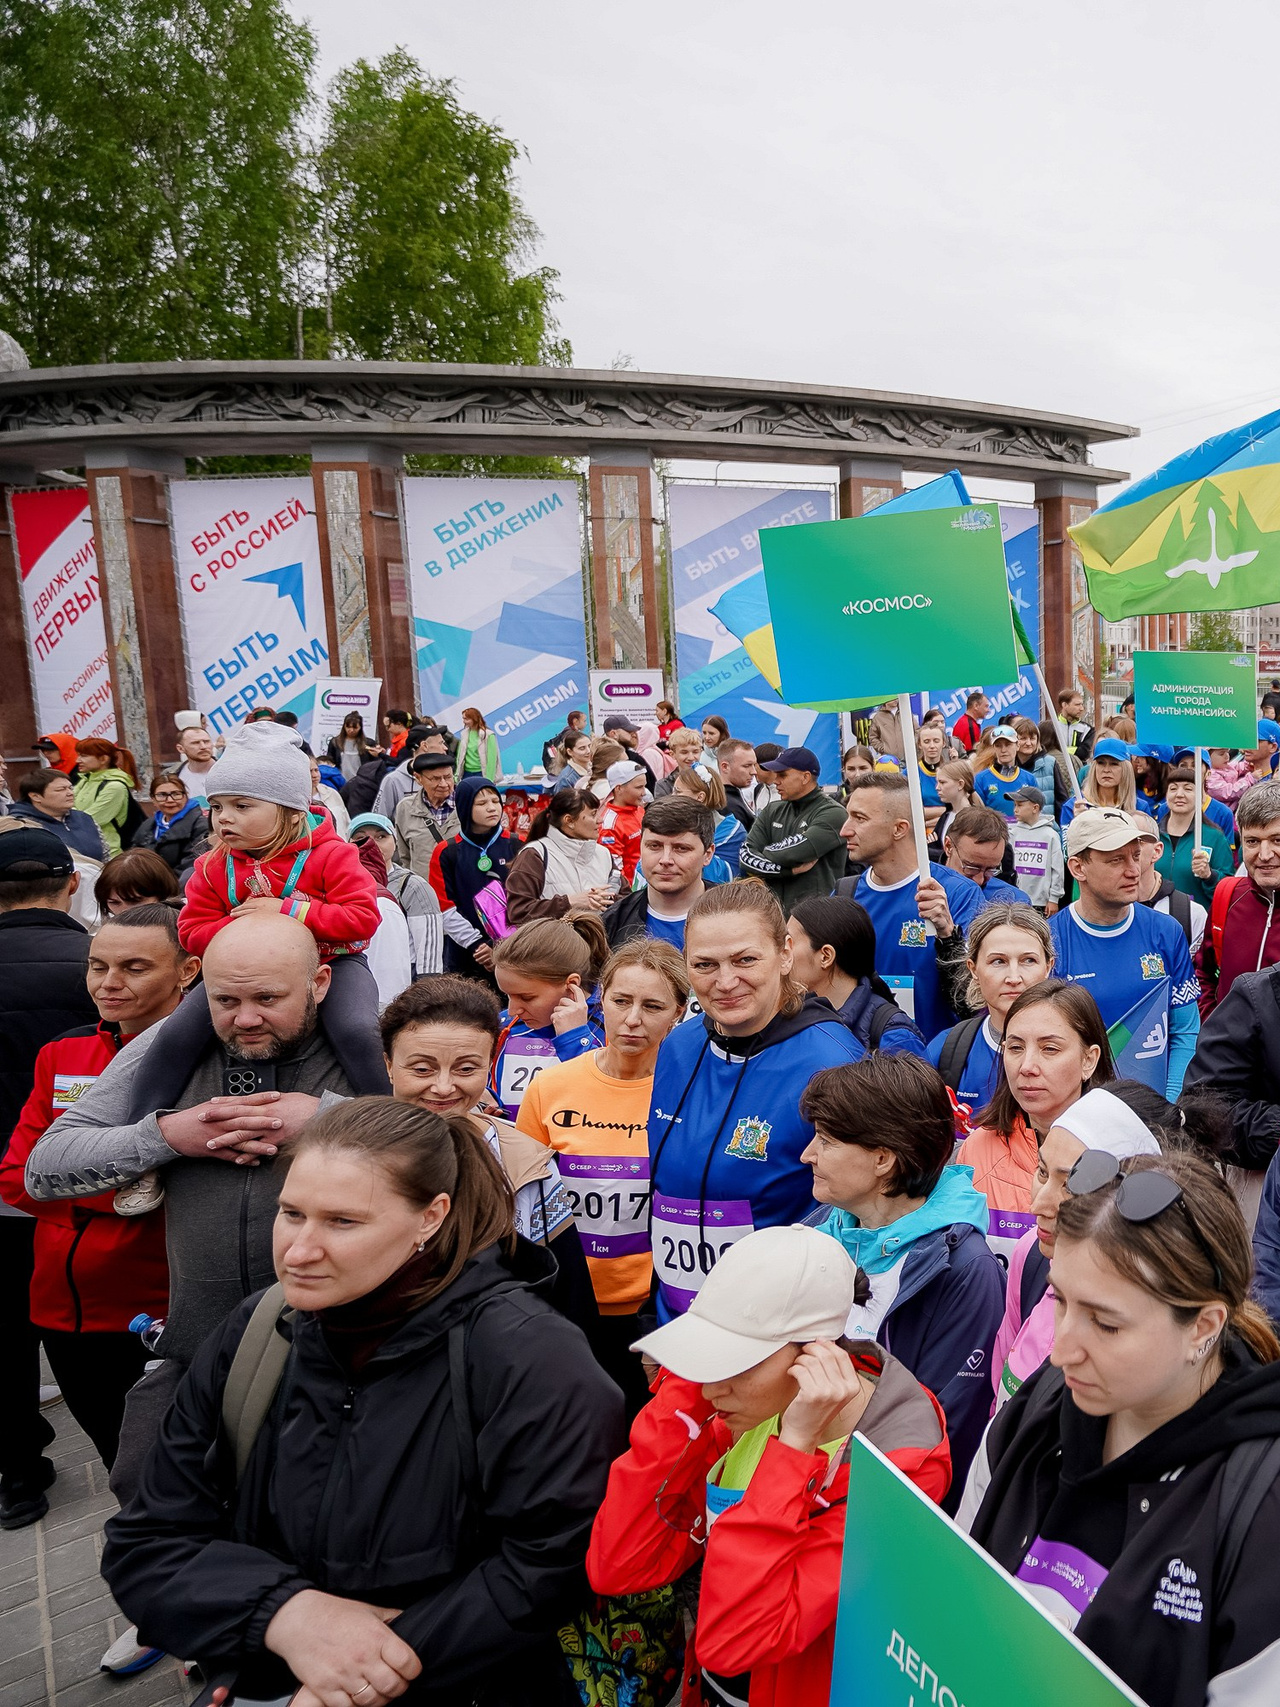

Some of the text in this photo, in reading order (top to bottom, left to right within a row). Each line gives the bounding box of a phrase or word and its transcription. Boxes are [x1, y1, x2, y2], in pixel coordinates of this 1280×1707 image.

[191, 509, 250, 556] БЫТЬ
[424, 492, 564, 578] В ДВИЖЕНИИ
[433, 498, 506, 545] БЫТЬ
[190, 497, 308, 592] С РОССИЕЙ
[685, 545, 740, 581] БЫТЬ
[841, 594, 933, 616] «КОСМОС»
[203, 630, 279, 692] БЫТЬ
[692, 664, 732, 695] БЫТЬ
[208, 638, 329, 734] ПЕРВЫМ
[1152, 684, 1234, 695] АДМИНИСТРАЦИЯ
[1174, 696, 1211, 705] ГОРОДА
[493, 679, 580, 737] СМЕЛЫМ
[1151, 706, 1237, 718] ХАНТЫ-МАНСИЙСК
[1018, 851, 1043, 863] 2078
[567, 1190, 650, 1222] 2017
[662, 1236, 734, 1276] 200
[886, 1628, 966, 1707] ДЕПО
